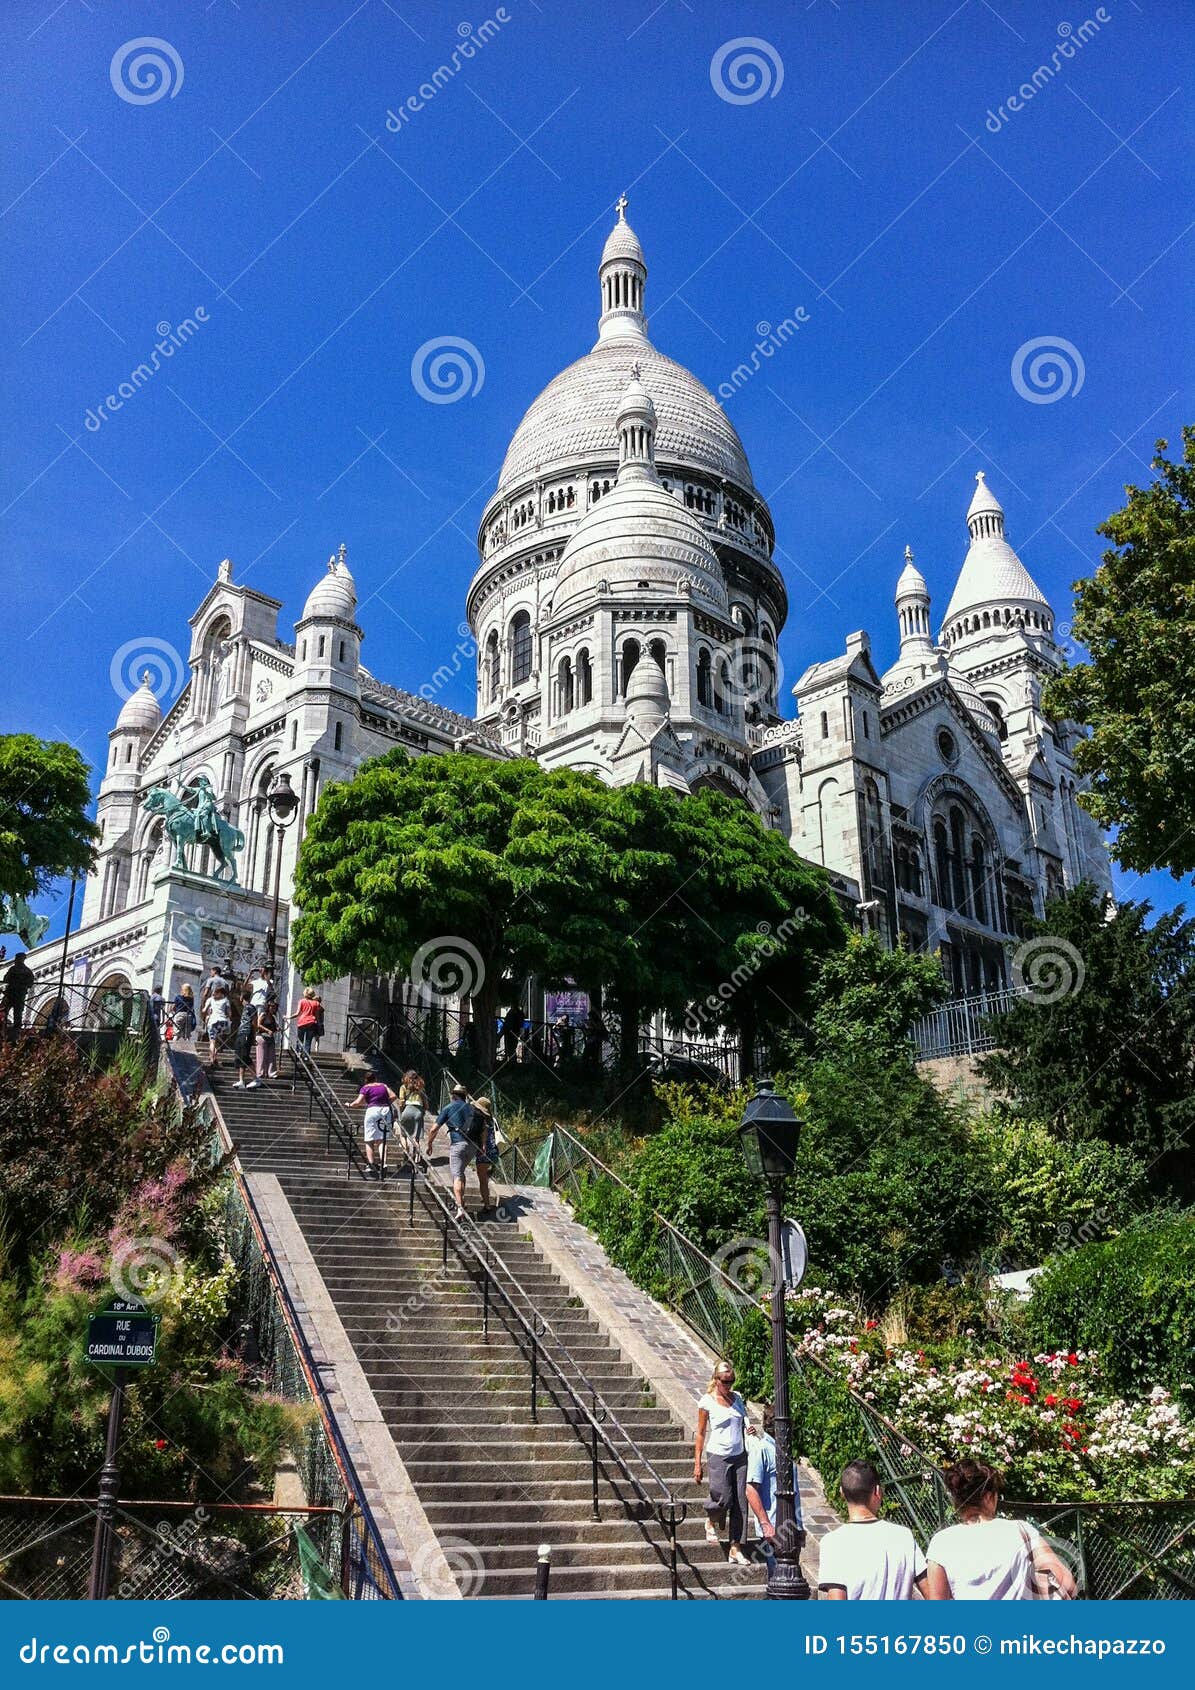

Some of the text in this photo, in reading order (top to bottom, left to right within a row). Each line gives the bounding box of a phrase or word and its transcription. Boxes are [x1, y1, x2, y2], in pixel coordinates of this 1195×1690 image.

[116, 1320, 131, 1331] RUE
[88, 1344, 153, 1356] CARDINAL DUBOIS
